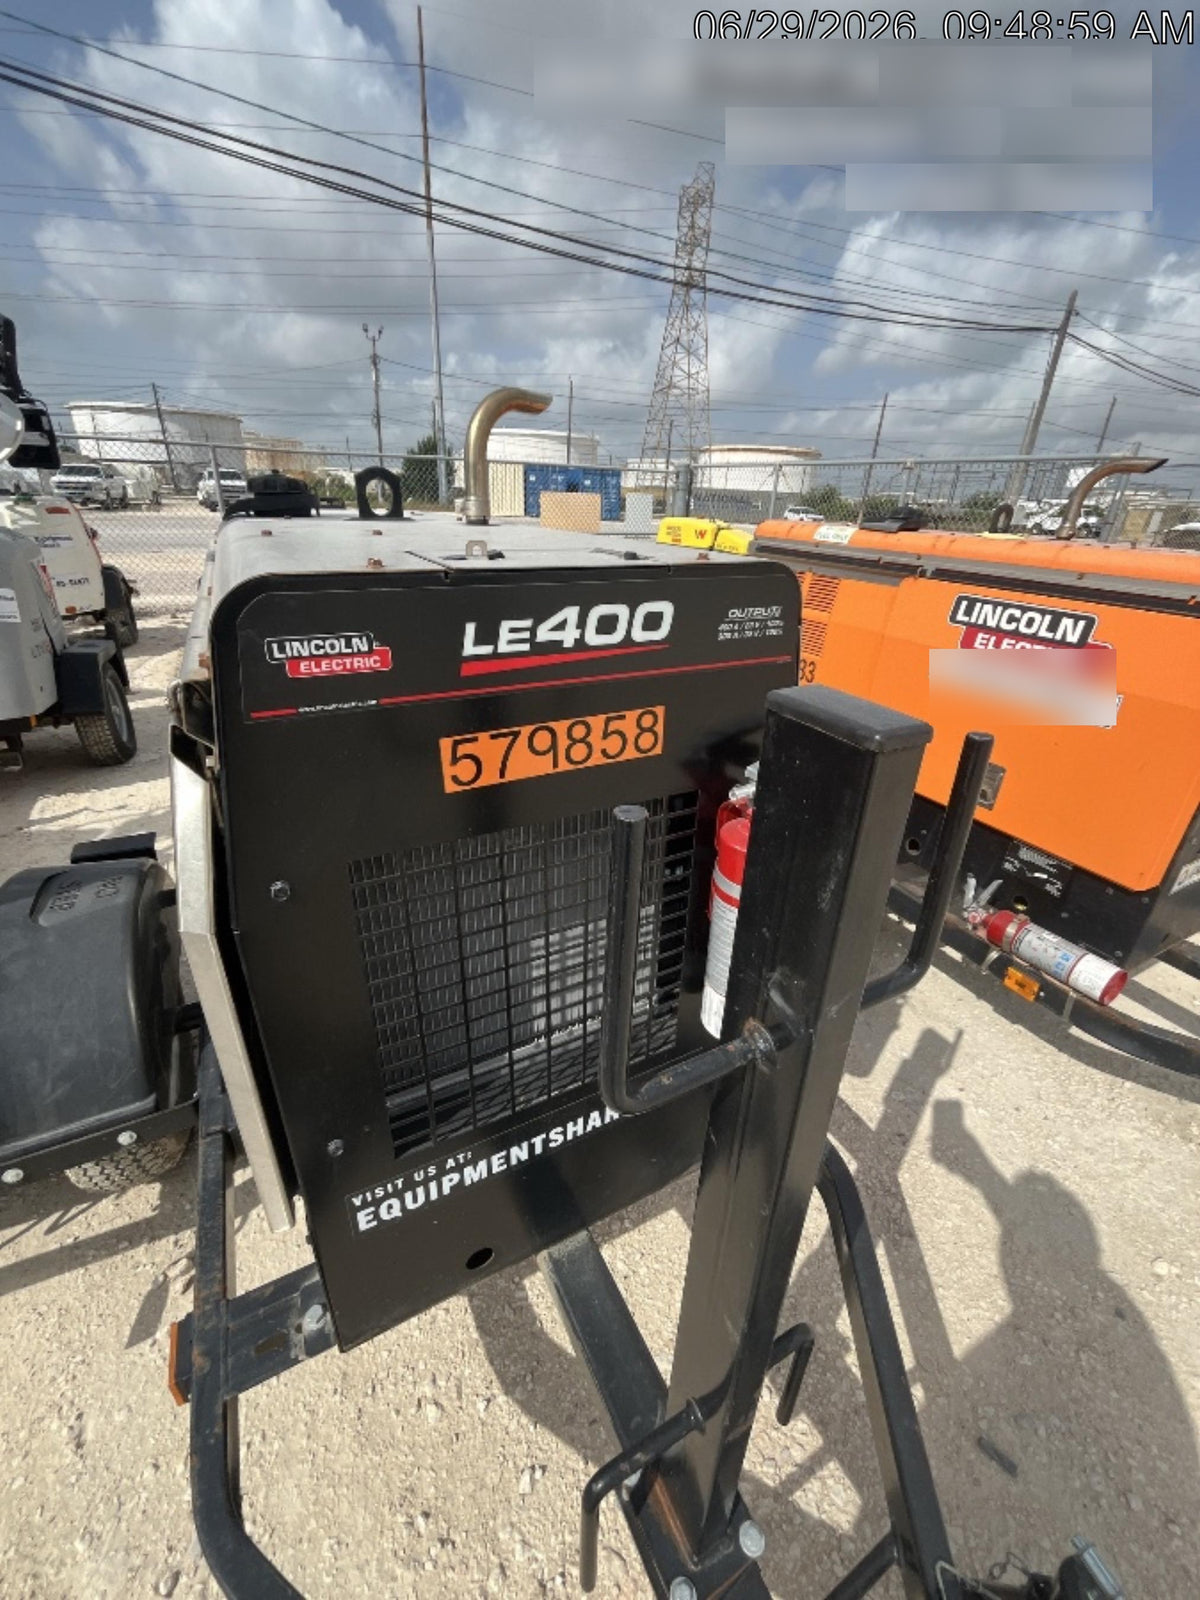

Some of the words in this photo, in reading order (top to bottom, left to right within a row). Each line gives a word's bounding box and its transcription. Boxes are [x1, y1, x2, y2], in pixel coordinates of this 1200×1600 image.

[461, 601, 675, 657] LE400
[957, 600, 1087, 644] LINCOLN
[271, 636, 369, 659] LINCOLN
[299, 655, 382, 674] ELECTRIC
[449, 709, 659, 787] 579858
[352, 1178, 404, 1207] VISIT
[413, 1165, 437, 1182] US
[446, 1151, 472, 1170] AT:
